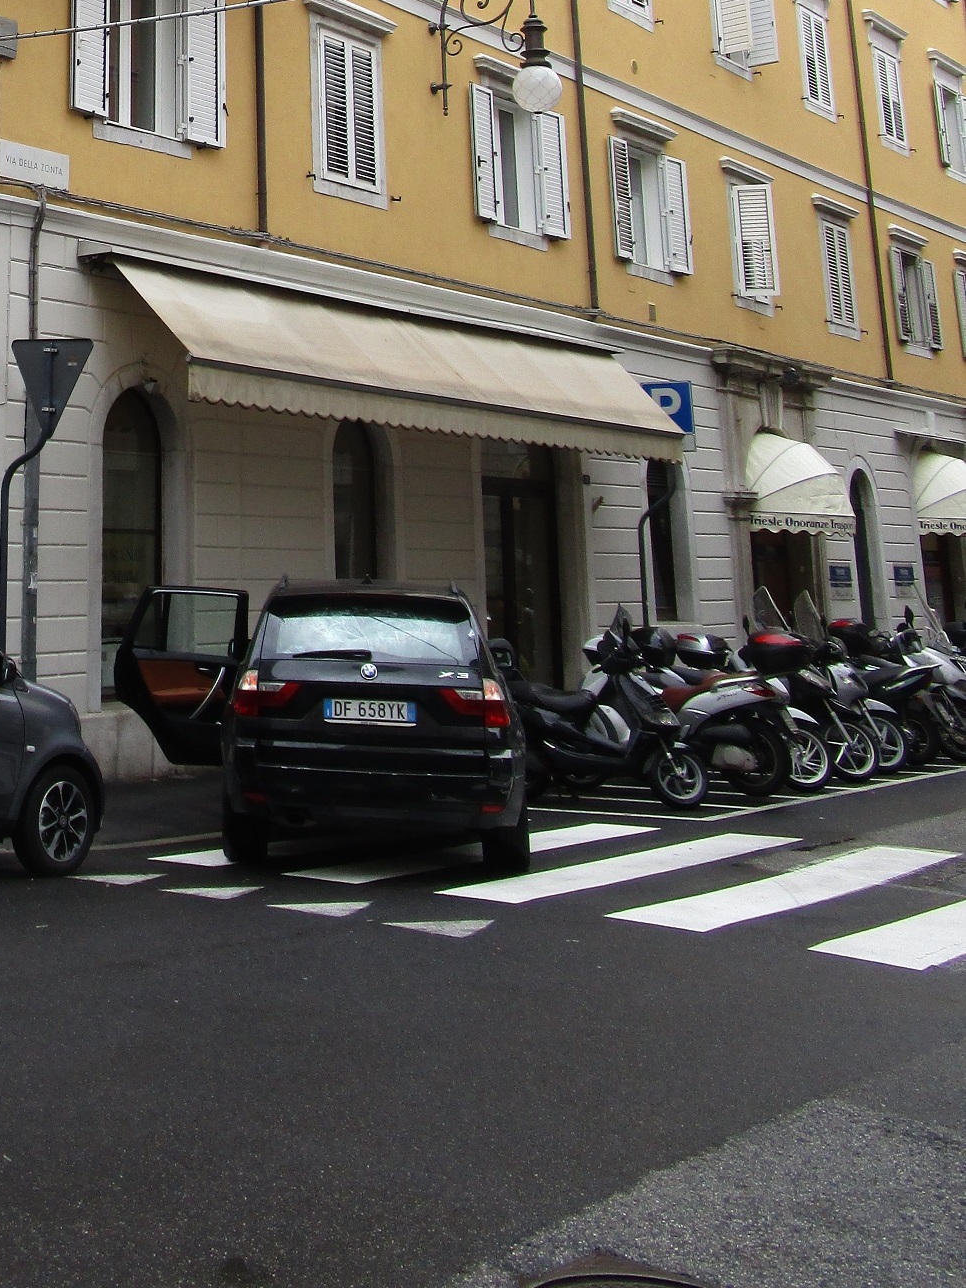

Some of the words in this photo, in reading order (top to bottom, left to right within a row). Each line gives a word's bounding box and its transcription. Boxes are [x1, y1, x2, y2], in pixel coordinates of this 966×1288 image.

[5, 155, 16, 165] VIA
[19, 158, 38, 170] DELLA
[41, 163, 63, 176] ZONTA
[650, 387, 681, 415] P
[750, 514, 782, 527] Trieste
[785, 516, 829, 529] Onoranze
[919, 520, 948, 530] Trieste
[438, 671, 469, 679] X3
[334, 701, 351, 717] DF
[358, 702, 406, 719] 658YK
